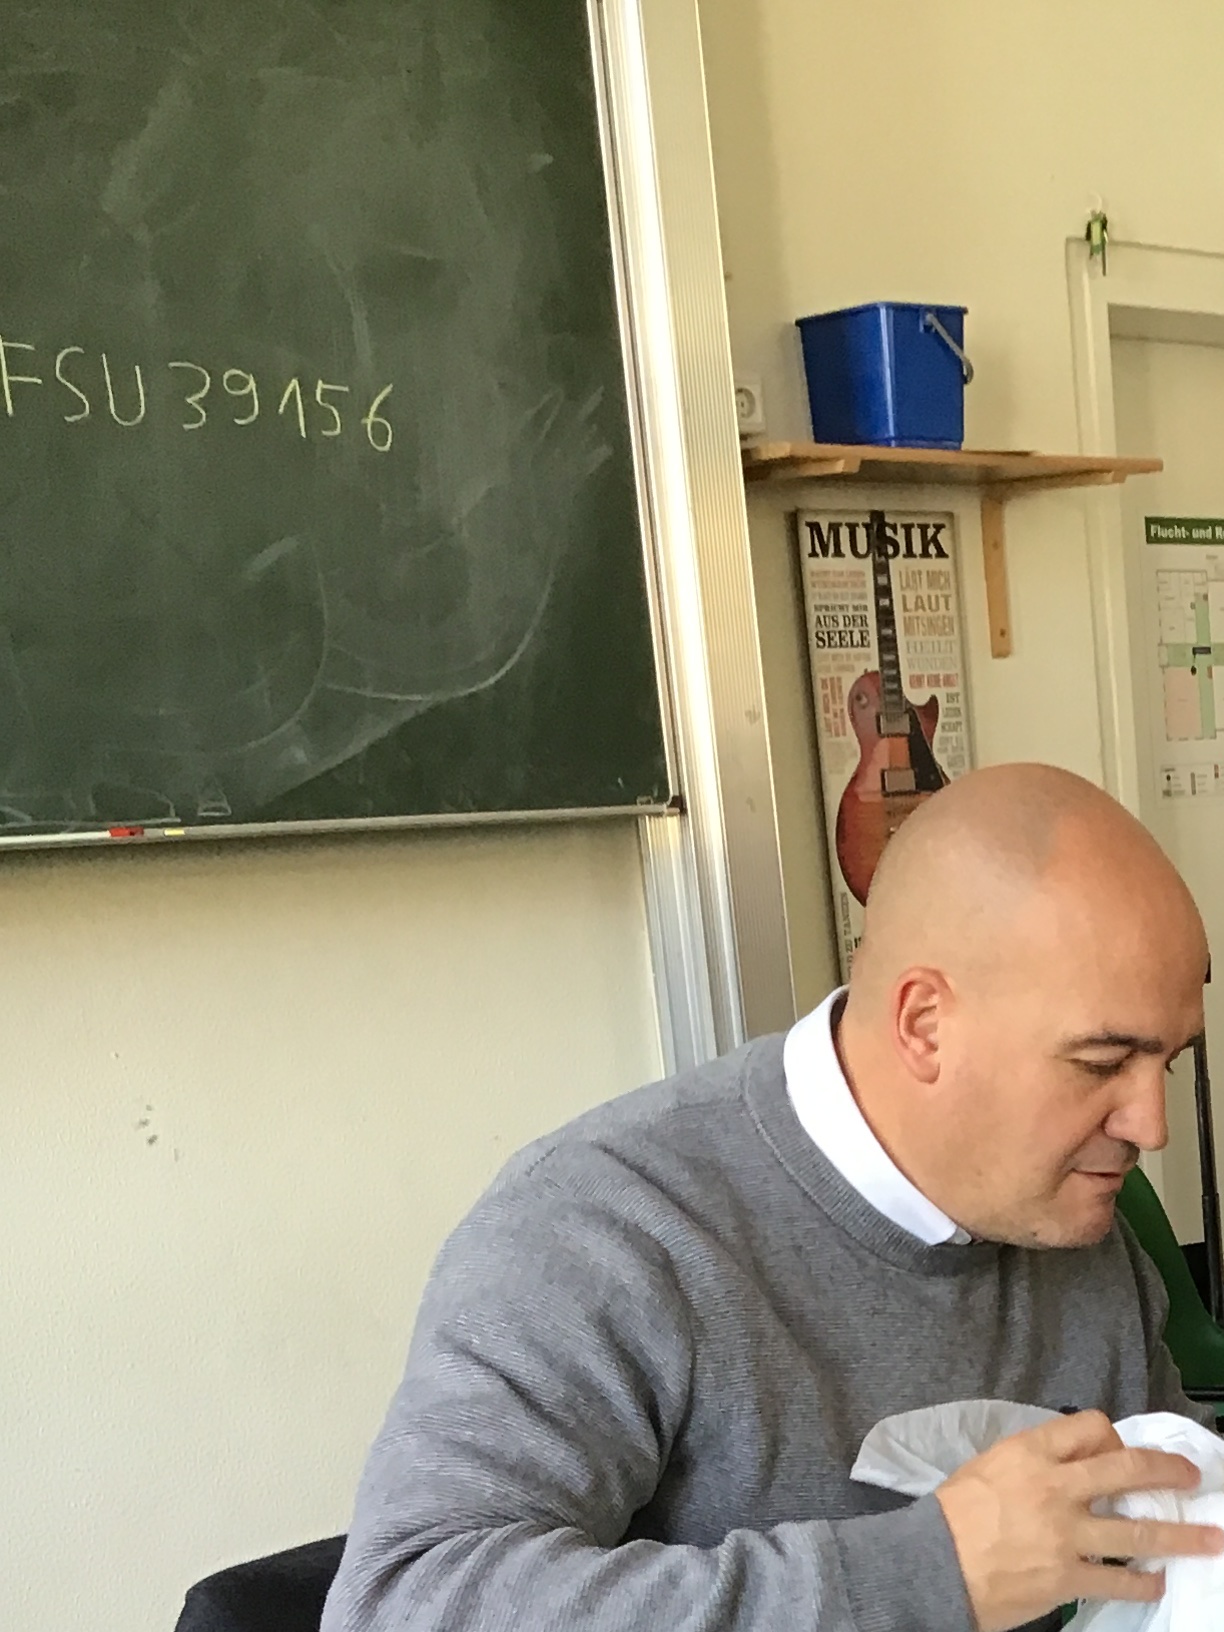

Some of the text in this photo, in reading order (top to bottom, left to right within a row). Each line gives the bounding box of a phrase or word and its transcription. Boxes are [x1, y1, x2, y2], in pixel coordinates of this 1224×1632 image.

[805, 521, 950, 559] MUSIK
[1192, 526, 1212, 539] und
[902, 594, 952, 613] LAUT
[815, 614, 869, 629] AUS DER
[815, 629, 871, 649] SEELE
